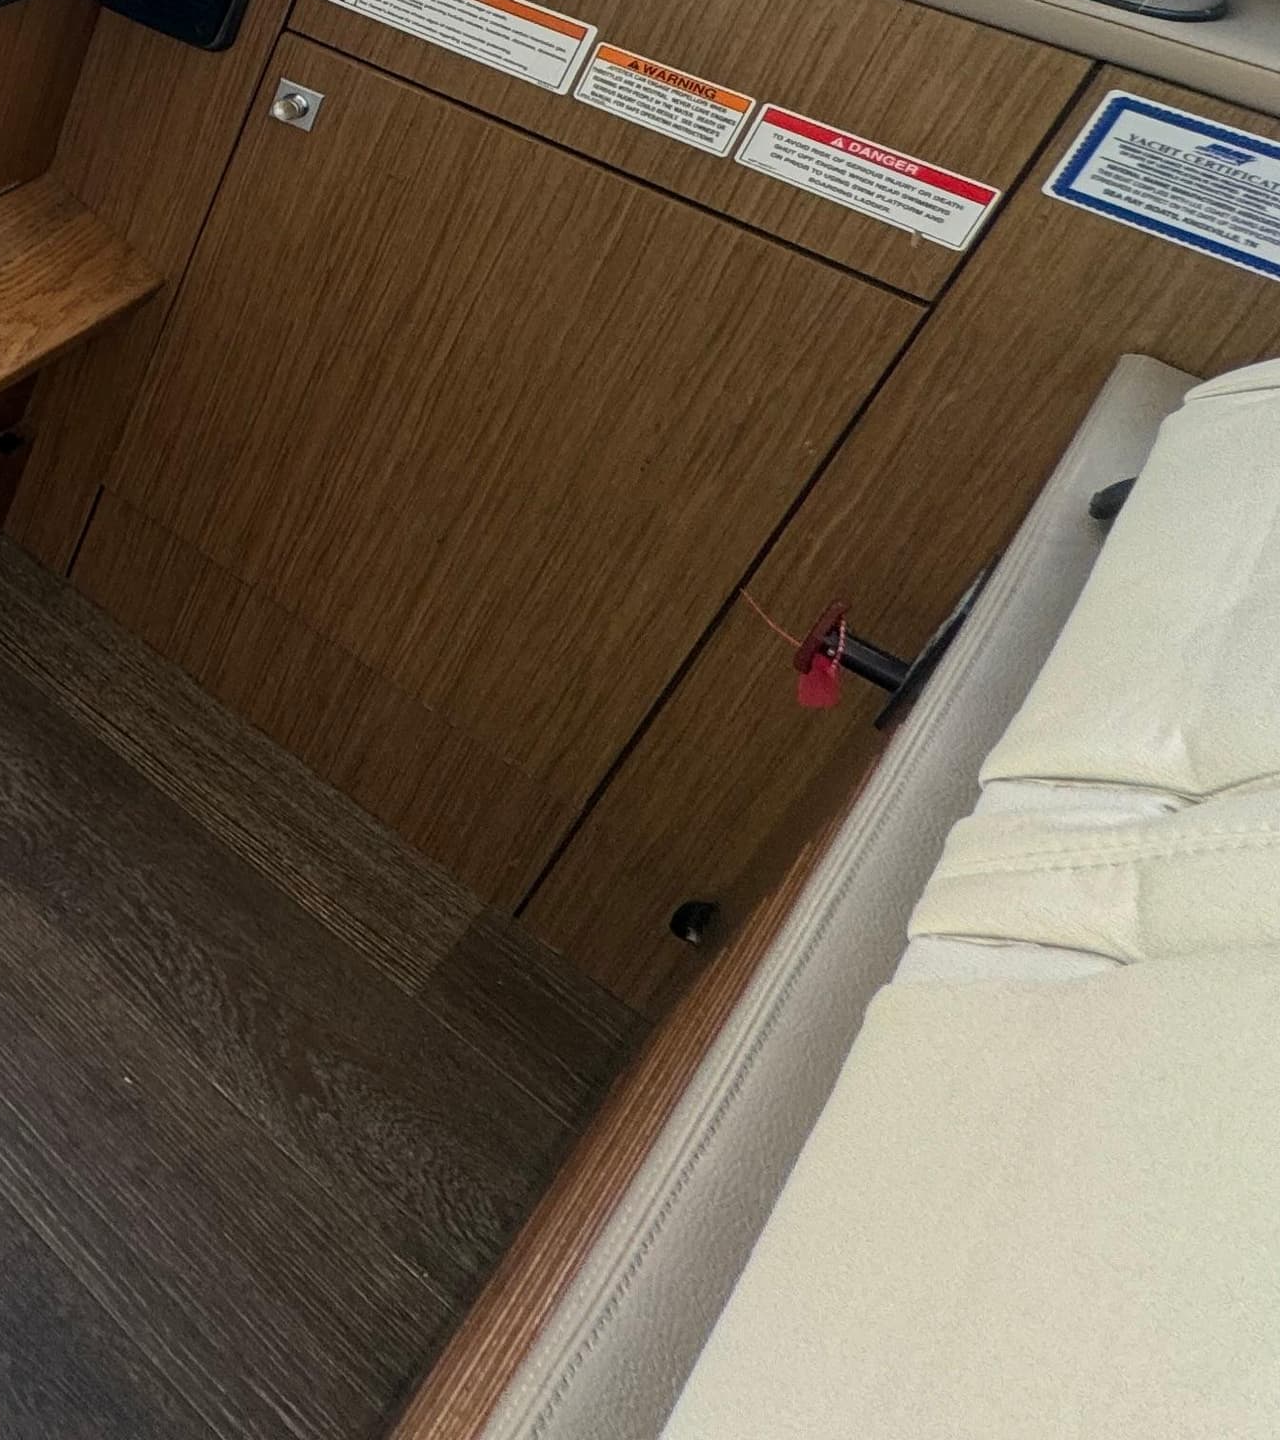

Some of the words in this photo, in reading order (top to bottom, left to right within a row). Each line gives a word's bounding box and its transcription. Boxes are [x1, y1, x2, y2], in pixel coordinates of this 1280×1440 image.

[643, 64, 717, 99] WARNING
[848, 142, 919, 175] DANGER
[1129, 133, 1182, 156] YACHT
[773, 133, 784, 141] TO
[784, 138, 810, 151] AVOID
[810, 148, 831, 159] RISK
[845, 161, 884, 179] SERIOUS
[884, 176, 917, 192] INJURY
[917, 189, 932, 198] OR
[774, 144, 796, 155] SHUT
[815, 160, 847, 175] ENGINE
[848, 172, 875, 186] WHEN
[875, 183, 900, 196] NEAR
[770, 152, 783, 160] OR
[783, 157, 810, 171] PRIOR
[812, 167, 823, 176] TO
[823, 173, 850, 187] USING
[851, 184, 875, 197] SWIM
[875, 194, 924, 215] PLATFORM
[923, 213, 944, 223] AND
[808, 177, 853, 198] BOARDING
